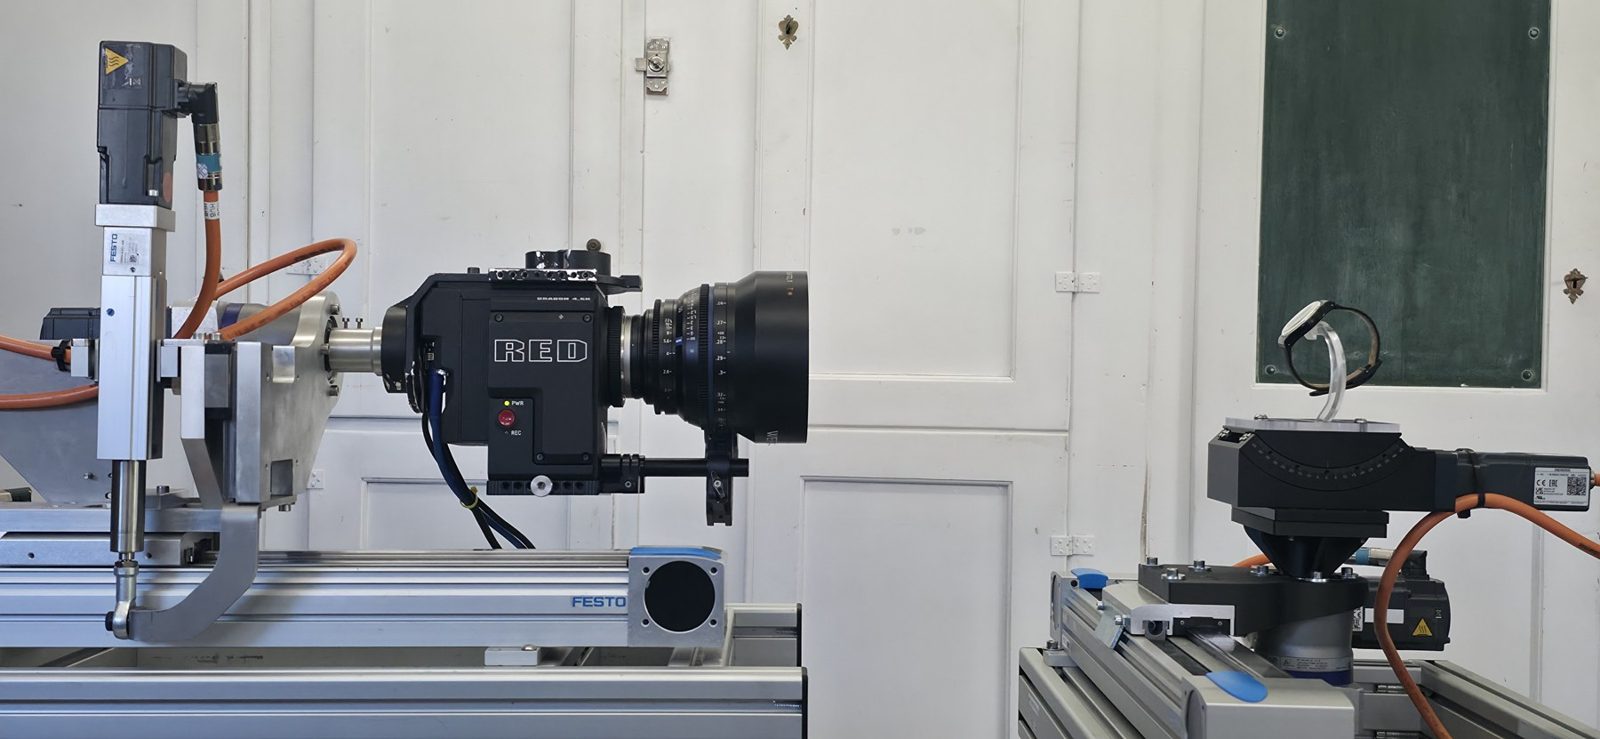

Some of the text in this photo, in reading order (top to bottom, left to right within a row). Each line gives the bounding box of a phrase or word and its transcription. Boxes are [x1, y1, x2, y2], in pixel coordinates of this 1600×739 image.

[110, 233, 118, 262] FESTO
[494, 339, 588, 362] RED
[572, 596, 626, 607] FESTO
